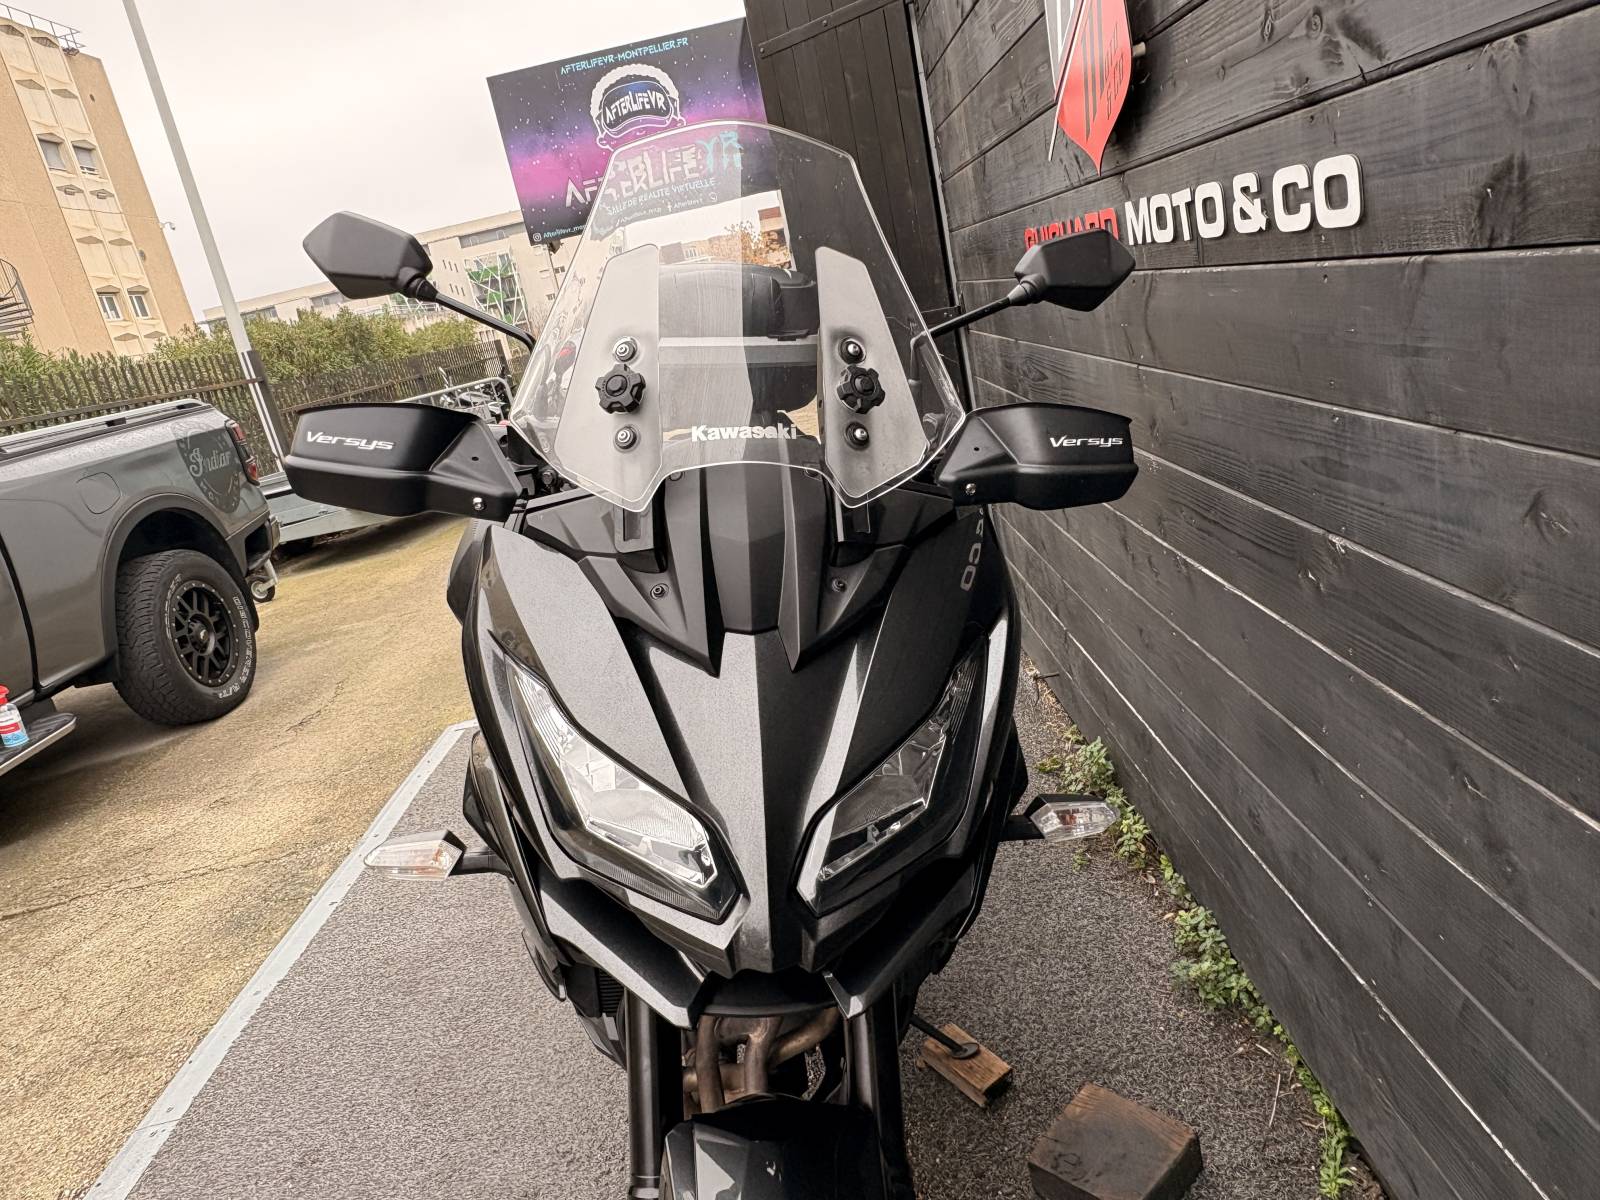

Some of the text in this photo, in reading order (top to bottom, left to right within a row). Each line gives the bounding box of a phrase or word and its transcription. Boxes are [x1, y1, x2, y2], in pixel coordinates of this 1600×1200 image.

[560, 37, 689, 75] AFTERLIFEVR-MONTPELLIER.FR
[605, 89, 667, 124] AFTERLIFEVR
[1125, 181, 1226, 246] MOTO
[1272, 154, 1363, 233] CO
[306, 431, 395, 450] Versys
[691, 422, 797, 442] Kawasaki
[1049, 434, 1124, 448] Versys
